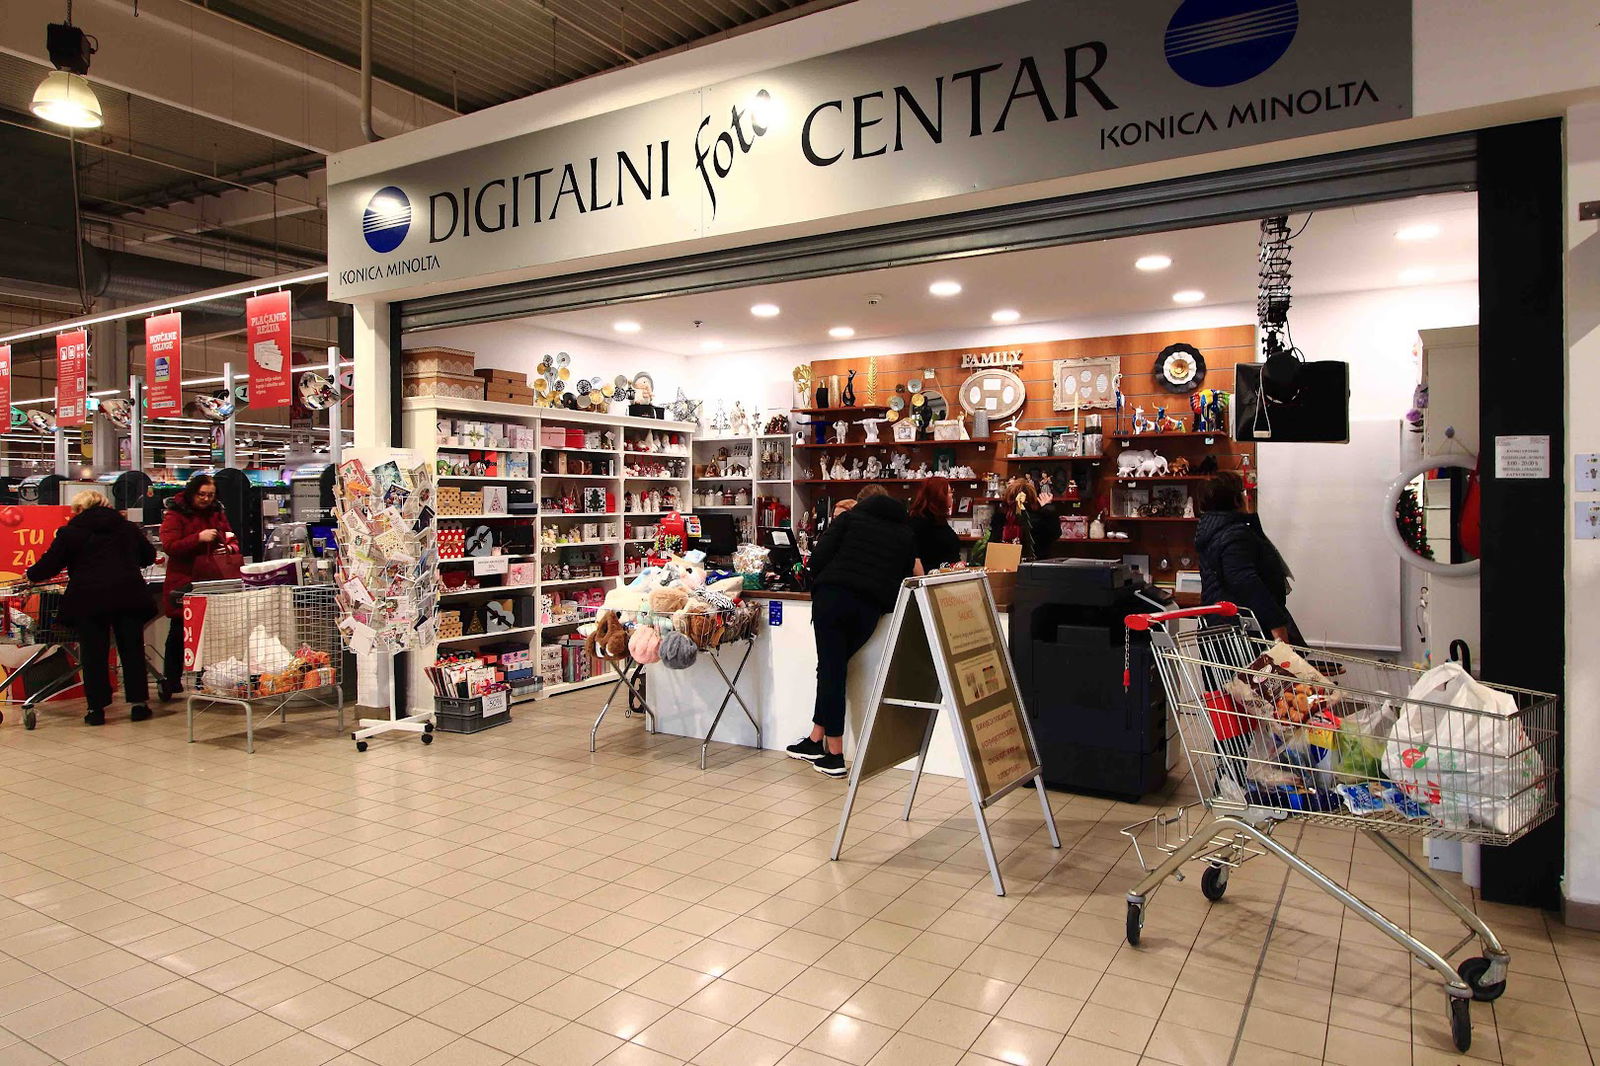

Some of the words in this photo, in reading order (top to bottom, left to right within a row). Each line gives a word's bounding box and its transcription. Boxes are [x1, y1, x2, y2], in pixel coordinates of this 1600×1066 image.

[1100, 109, 1218, 150] KONICA
[1227, 80, 1379, 128] MINOLTA
[428, 140, 670, 244] DIGITALNI
[694, 89, 775, 221] foto
[801, 40, 1120, 167] CENTAR
[339, 266, 383, 286] KONICA
[386, 254, 440, 276] MINOLTA
[962, 350, 1023, 367] FAMILY
[13, 529, 45, 546] TU
